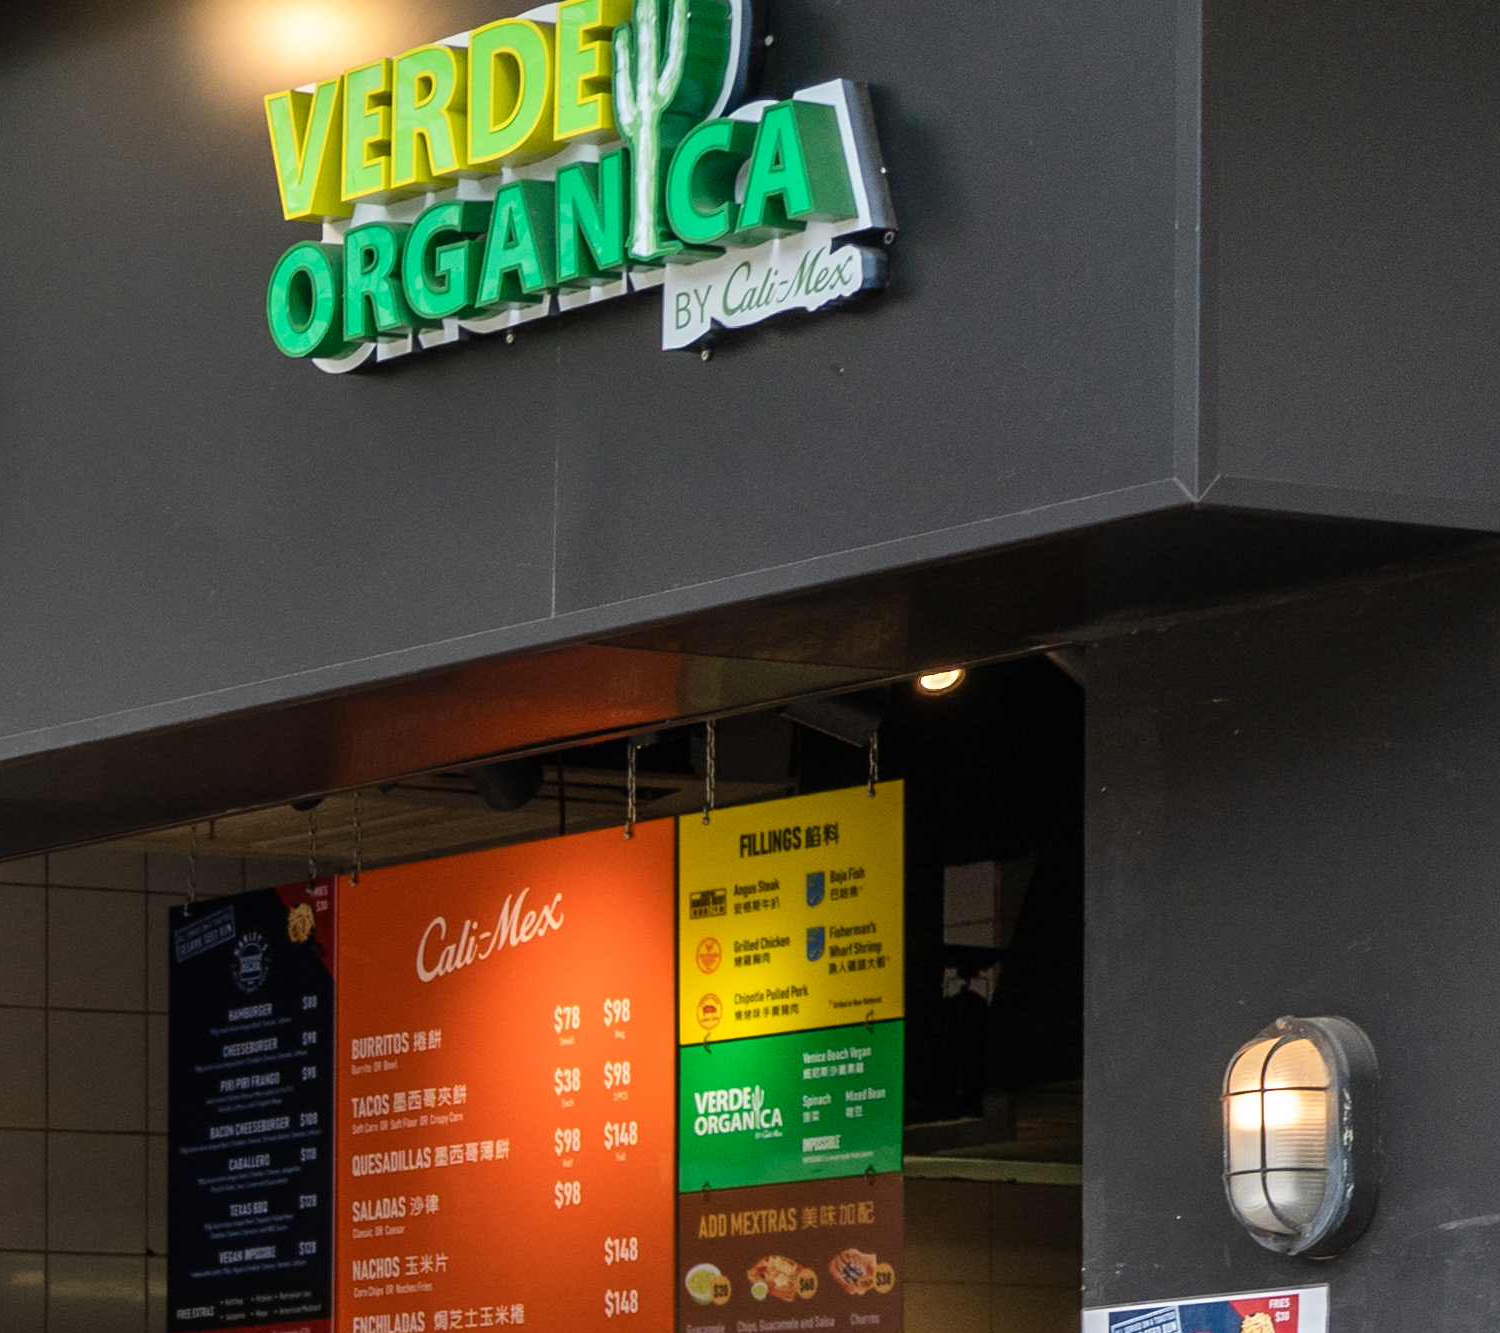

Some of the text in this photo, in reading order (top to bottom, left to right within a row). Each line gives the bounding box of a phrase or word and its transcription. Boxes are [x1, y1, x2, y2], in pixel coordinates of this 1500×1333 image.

[264, 0, 625, 221] VERDE
[674, 245, 855, 330] BY Cali-Mex
[739, 826, 802, 858] FILLINGS
[416, 887, 564, 982] Cali-Mex
[554, 998, 630, 1033] $78 $98
[351, 1031, 409, 1060] BURRITOS
[554, 1062, 631, 1096] $38 $98
[352, 1093, 390, 1119] TACOS
[694, 1087, 751, 1114] VERDE
[554, 1121, 638, 1156] $98 $148
[352, 1147, 432, 1177] QUESADILLAS
[352, 1196, 406, 1222] SALADAS
[554, 1181, 581, 1209] $98
[699, 1213, 727, 1238] ADD
[731, 1207, 797, 1236] MEXTRAS
[604, 1237, 638, 1265] $148
[352, 1256, 400, 1281] NACHOS
[604, 1289, 638, 1318] $148
